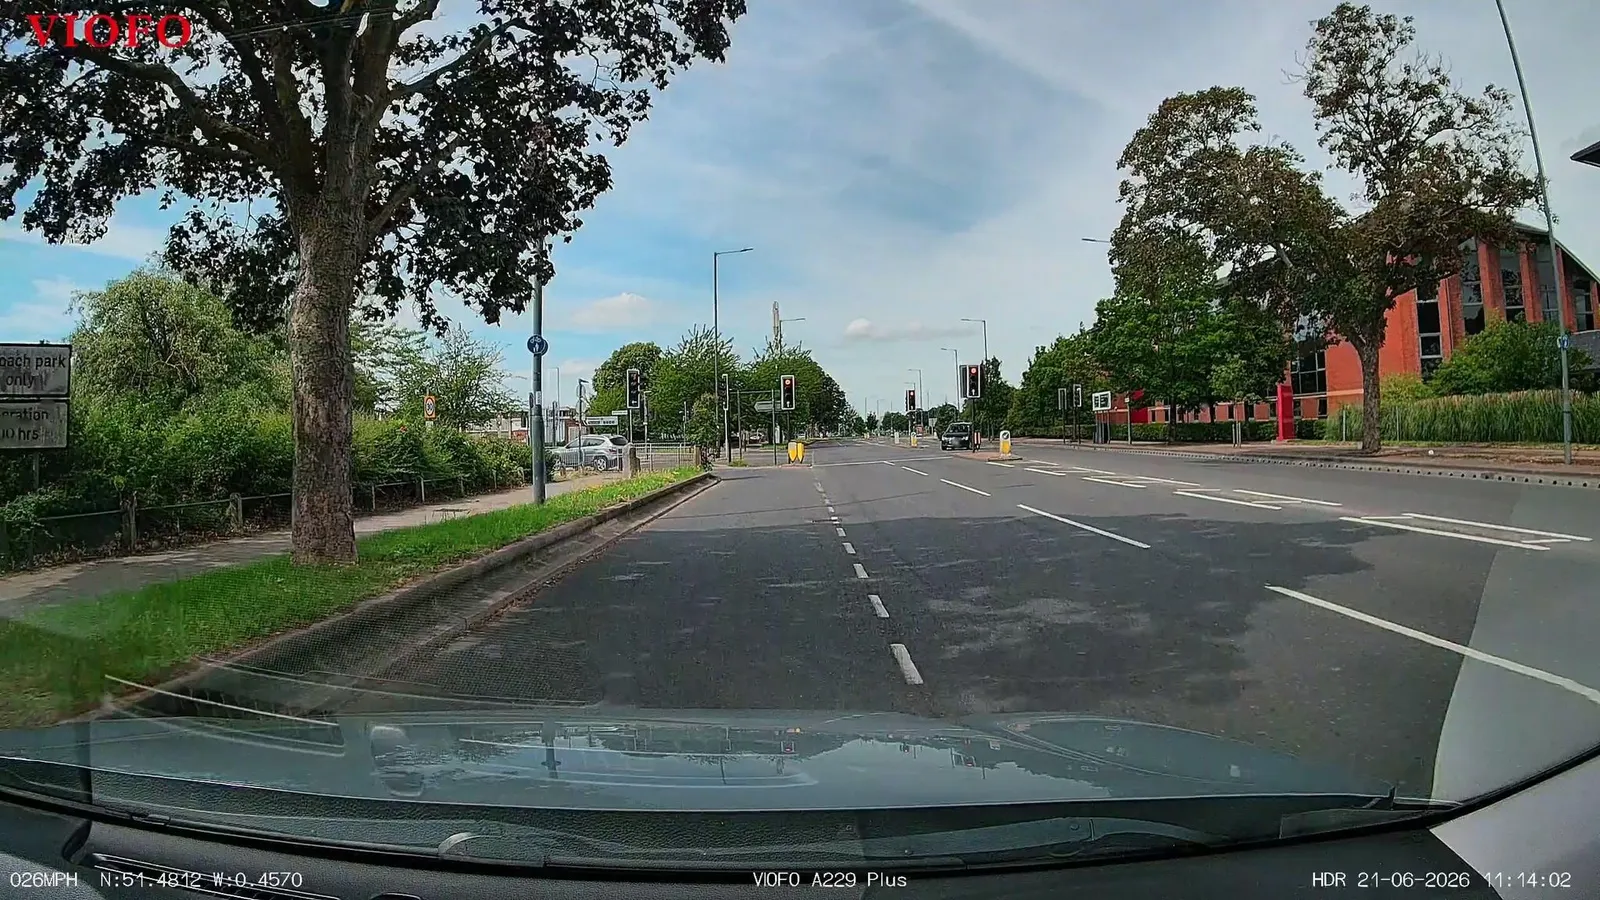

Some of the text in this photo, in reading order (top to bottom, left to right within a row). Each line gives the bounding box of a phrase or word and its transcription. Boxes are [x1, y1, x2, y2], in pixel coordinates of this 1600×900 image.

[36, 354, 66, 370] park
[6, 372, 36, 389] only
[18, 427, 39, 441] hrs
